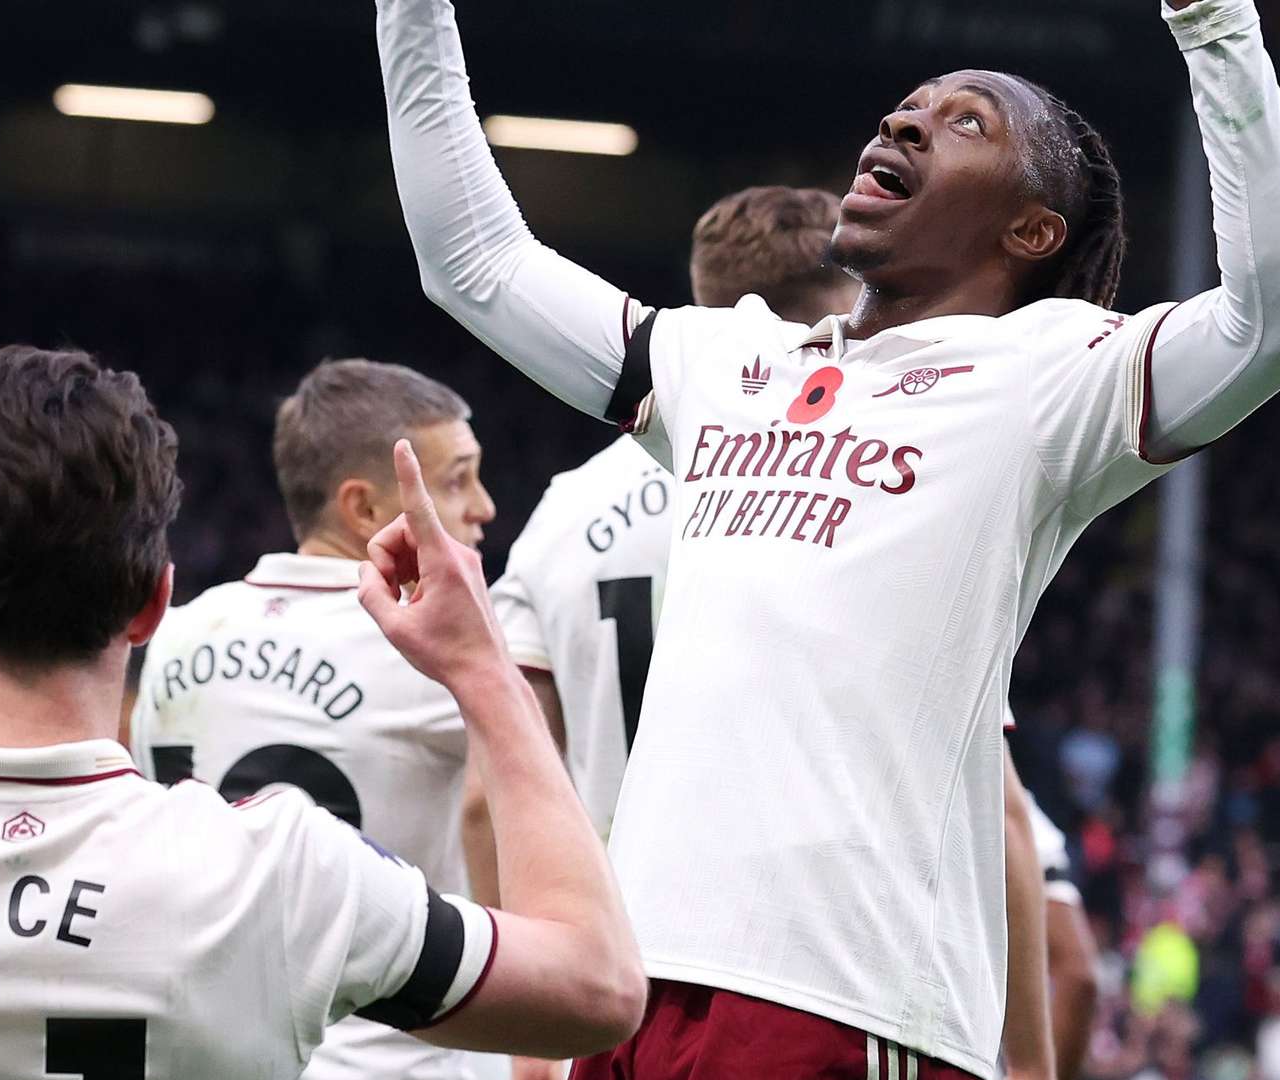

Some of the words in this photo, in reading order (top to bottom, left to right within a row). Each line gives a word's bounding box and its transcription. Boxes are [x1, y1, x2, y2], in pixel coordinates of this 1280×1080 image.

[684, 420, 923, 495] Emirates
[586, 466, 668, 553] GYÖ
[681, 489, 733, 541] FLY
[724, 490, 852, 548] BETTER
[152, 640, 363, 720] ROSSARD
[597, 575, 653, 762] 1
